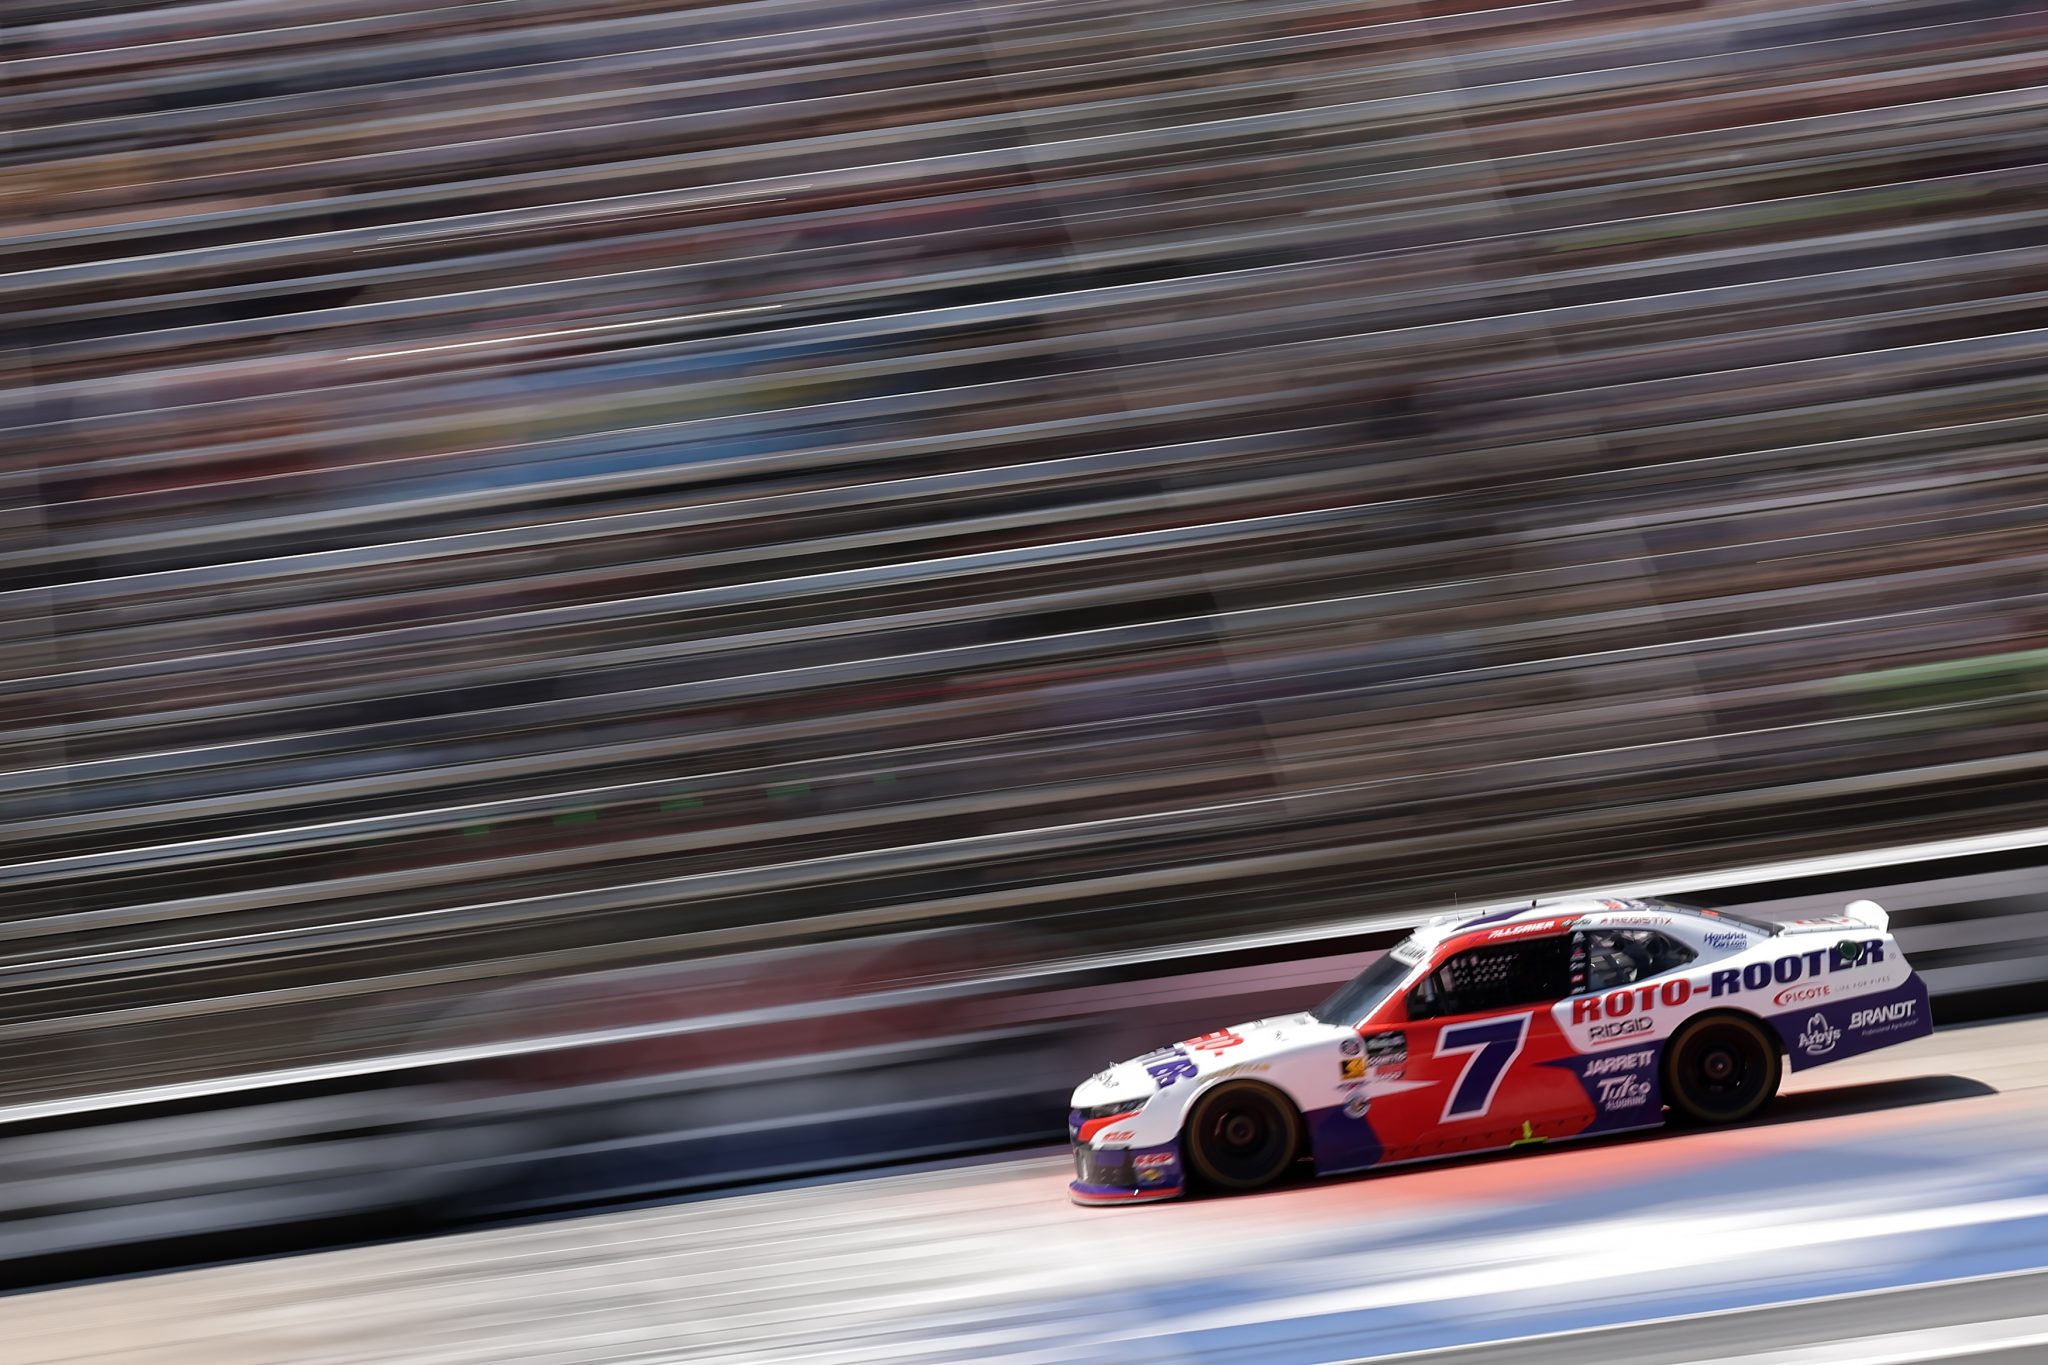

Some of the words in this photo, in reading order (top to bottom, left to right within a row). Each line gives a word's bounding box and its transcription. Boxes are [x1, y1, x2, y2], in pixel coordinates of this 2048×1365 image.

[1784, 985, 1831, 1003] PICOTE
[1589, 1016, 1654, 1039] RIDGID
[1848, 999, 1917, 1030] BRANDT
[1432, 1010, 1534, 1125] 7
[1582, 1049, 1656, 1078] JARRETT
[1596, 1073, 1652, 1103] Tufco
